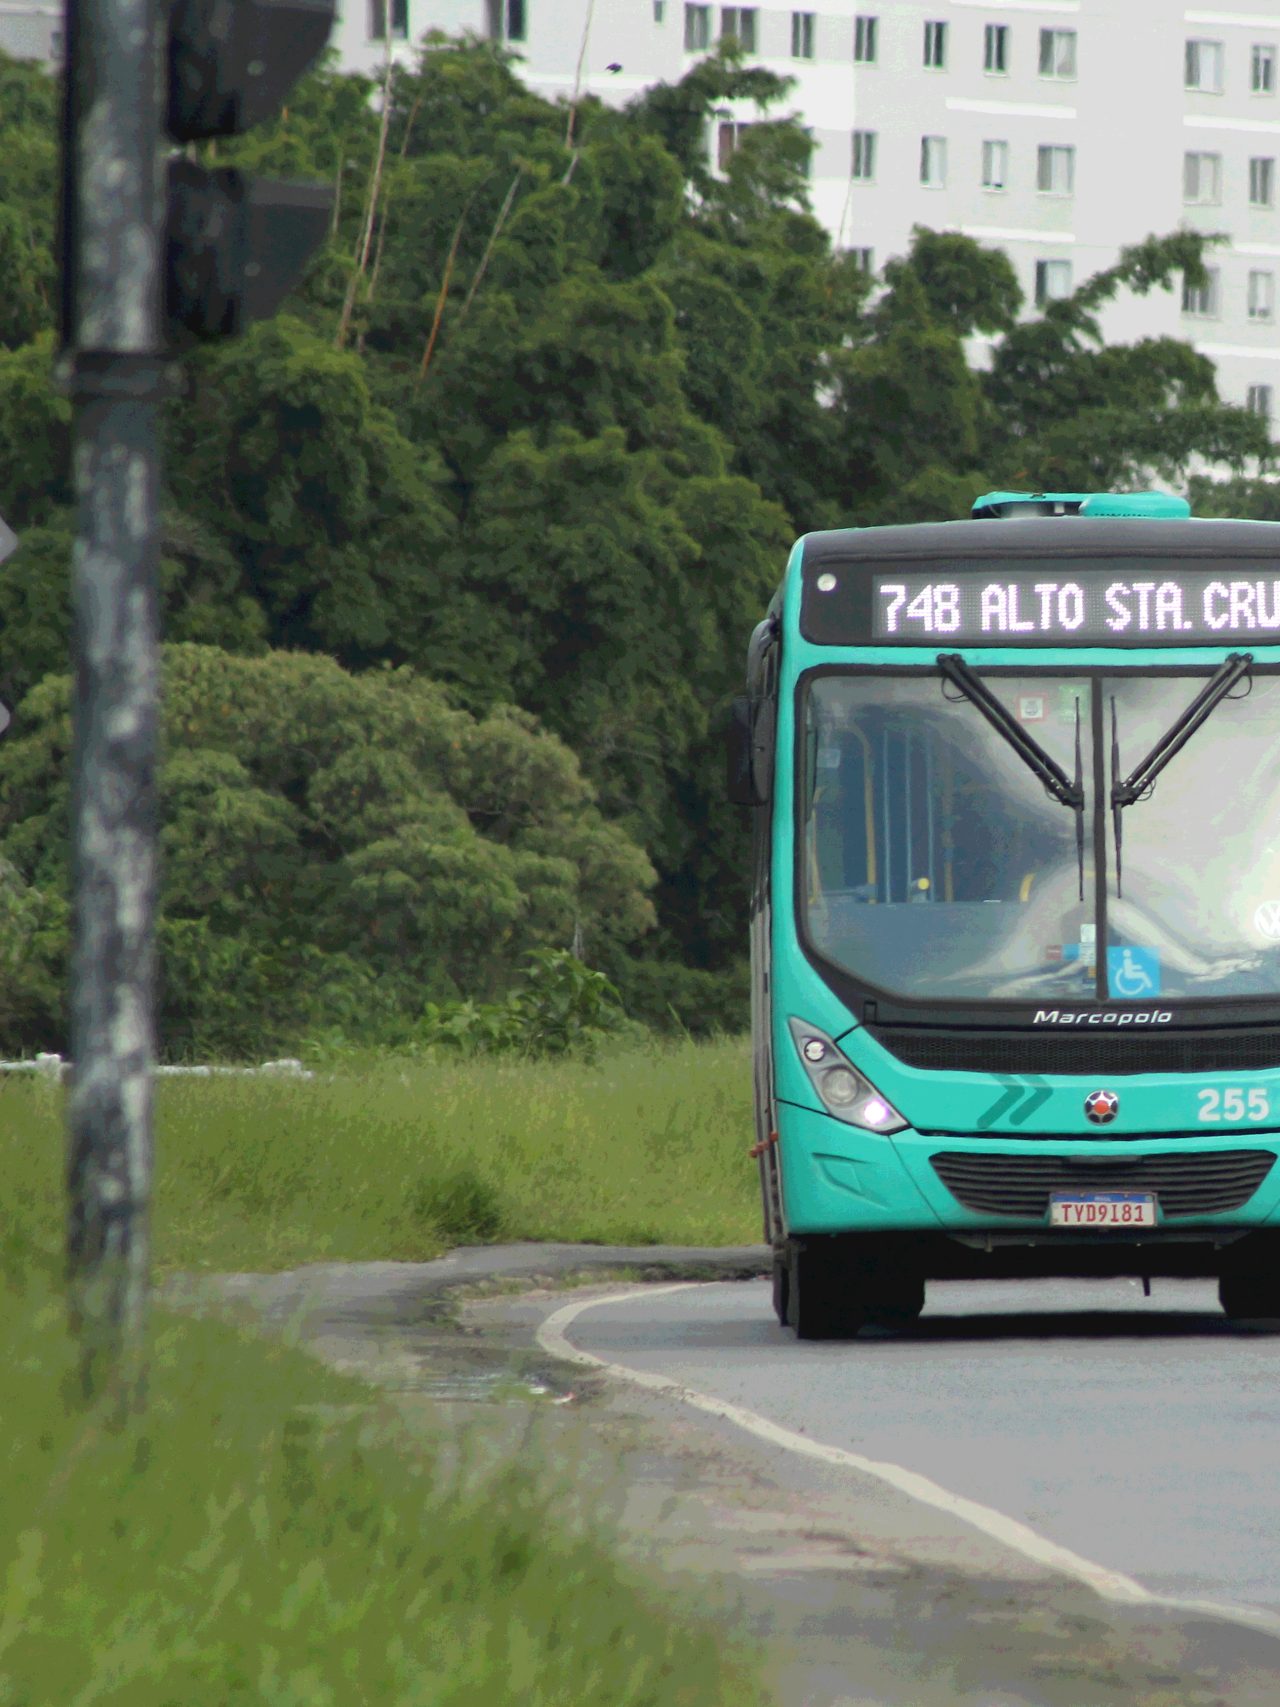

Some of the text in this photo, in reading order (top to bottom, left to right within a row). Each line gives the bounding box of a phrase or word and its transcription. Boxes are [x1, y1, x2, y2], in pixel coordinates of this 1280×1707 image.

[879, 583, 961, 632] 748
[980, 582, 1085, 632] ALTO
[1104, 581, 1193, 631] STA.
[1033, 1010, 1173, 1026] Marcopolo
[1197, 1088, 1270, 1121] 255
